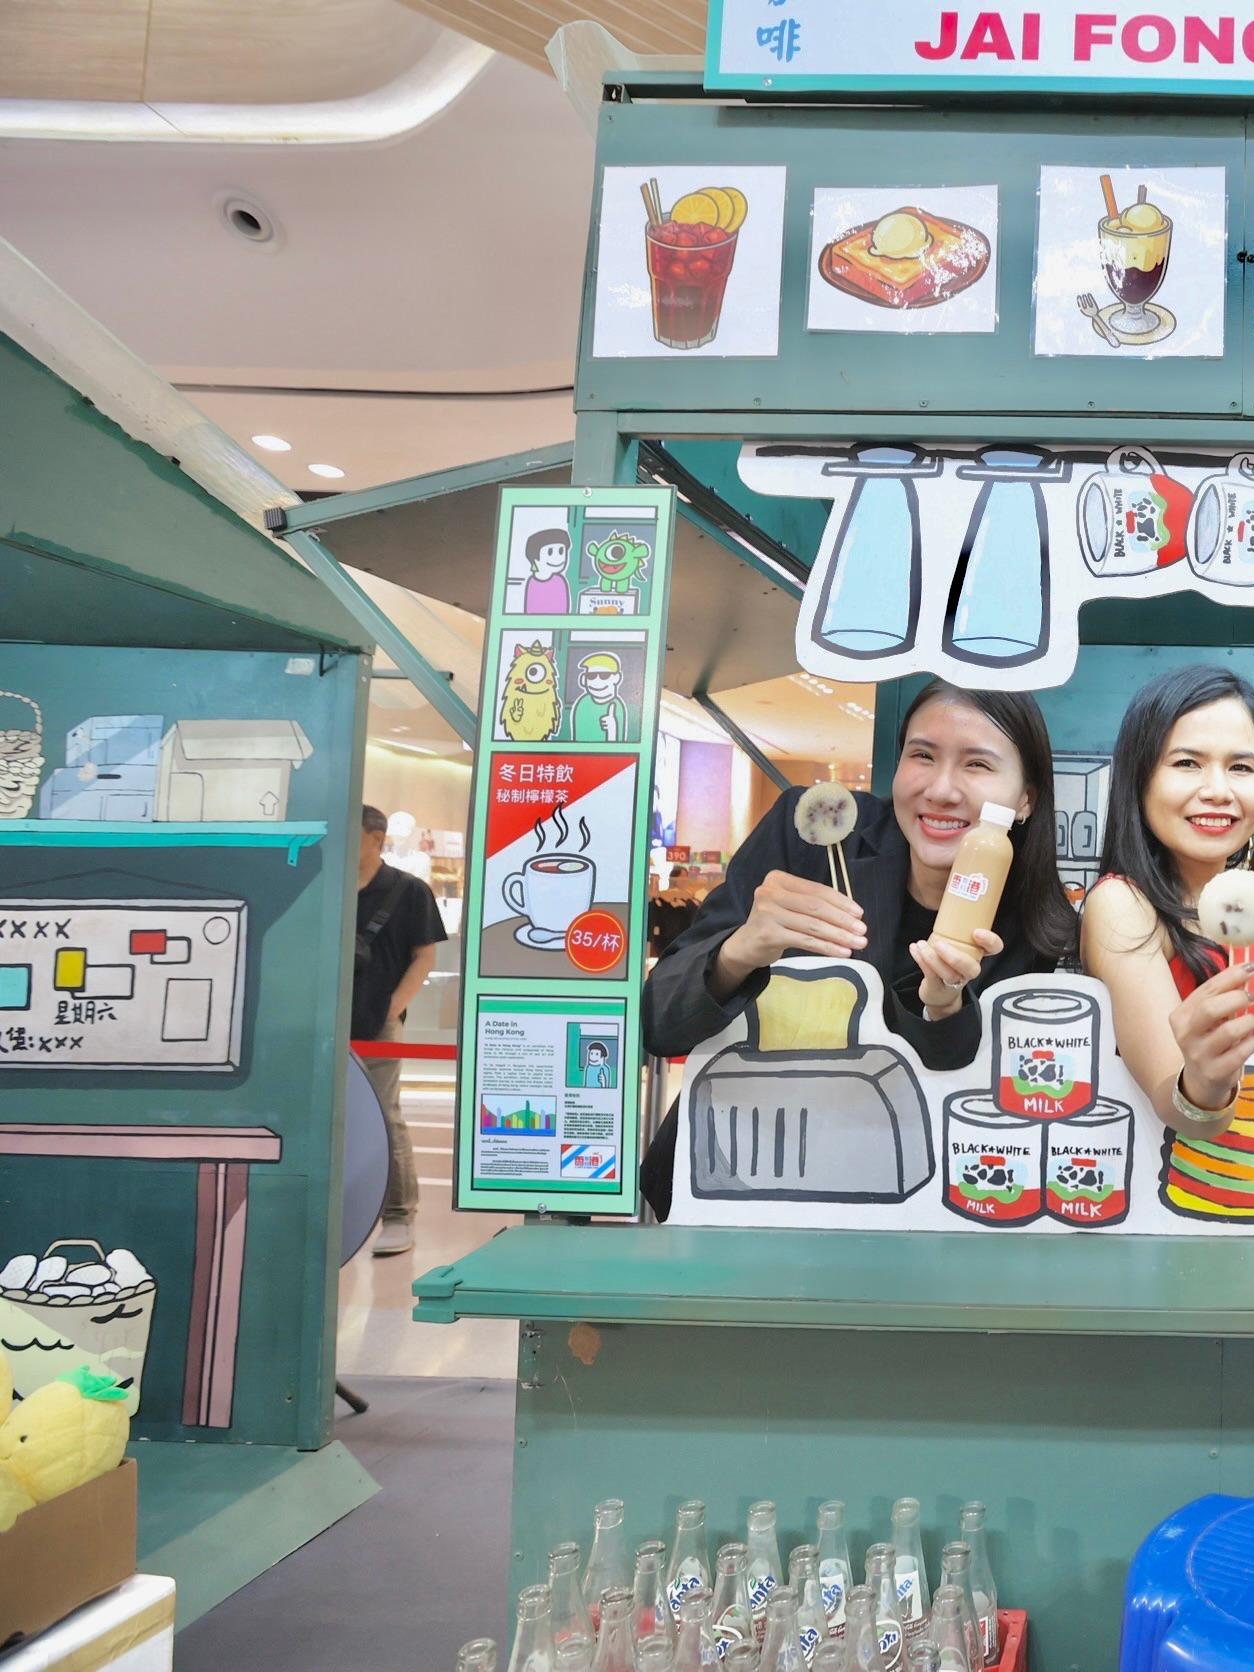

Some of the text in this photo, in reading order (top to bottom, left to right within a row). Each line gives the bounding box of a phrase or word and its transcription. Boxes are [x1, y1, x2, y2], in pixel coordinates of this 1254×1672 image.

[756, 0, 801, 63] 啡
[914, 12, 1040, 61] JAI
[1114, 530, 1126, 558] BLACK
[1222, 539, 1233, 564] BLACK
[588, 597, 625, 607] Sunny
[498, 763, 574, 783] 冬日特飲
[571, 930, 622, 952] 35/杯
[54, 1000, 118, 1026] 星期六
[484, 1028, 525, 1036] Hong Kong
[1008, 1036, 1091, 1050] BLACK WHITE
[1023, 1097, 1065, 1114] MILK
[952, 1142, 1031, 1157] BLACK WHITE
[1051, 1146, 1124, 1157] BLACK WHITE
[966, 1199, 996, 1215] MILK
[1061, 1202, 1103, 1218] MILK
